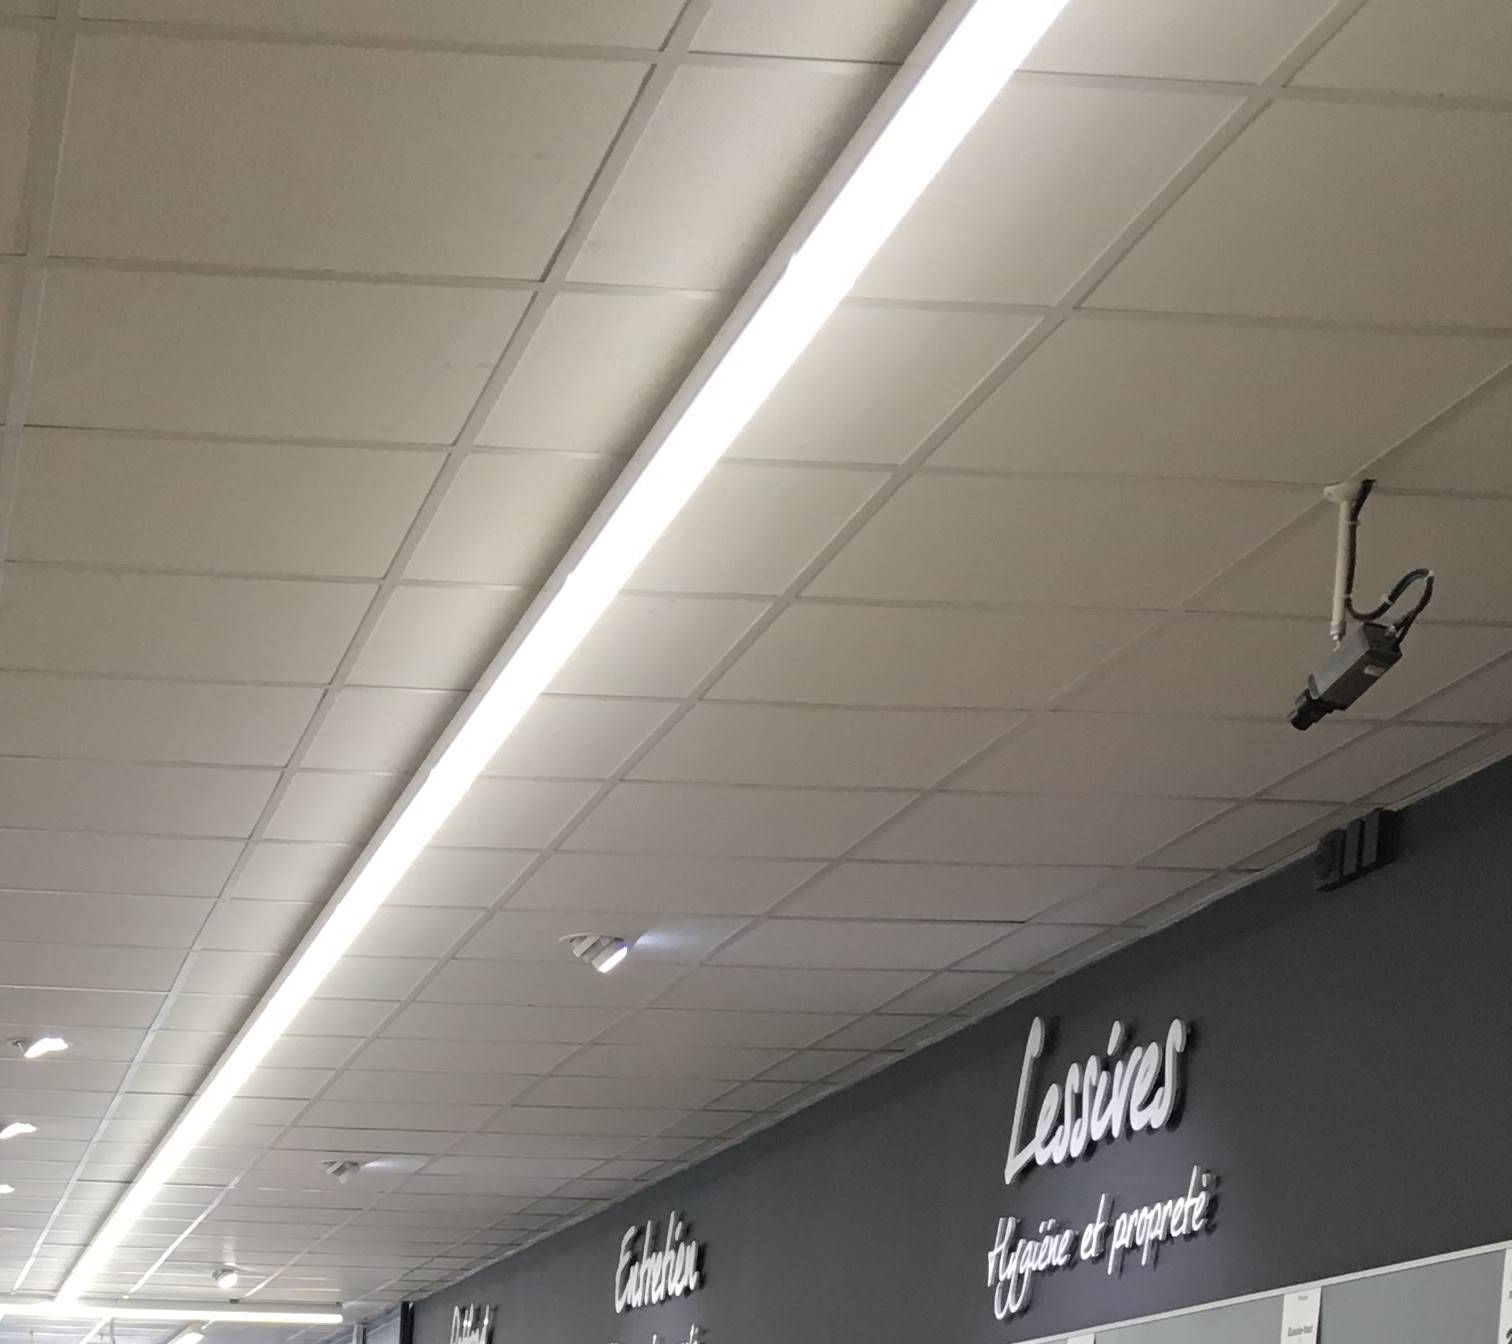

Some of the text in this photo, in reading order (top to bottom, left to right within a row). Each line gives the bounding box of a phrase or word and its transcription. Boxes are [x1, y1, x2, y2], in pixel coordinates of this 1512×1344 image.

[1004, 1016, 1187, 1185] Lessives
[987, 1164, 1212, 1320] Hygiène et propreté
